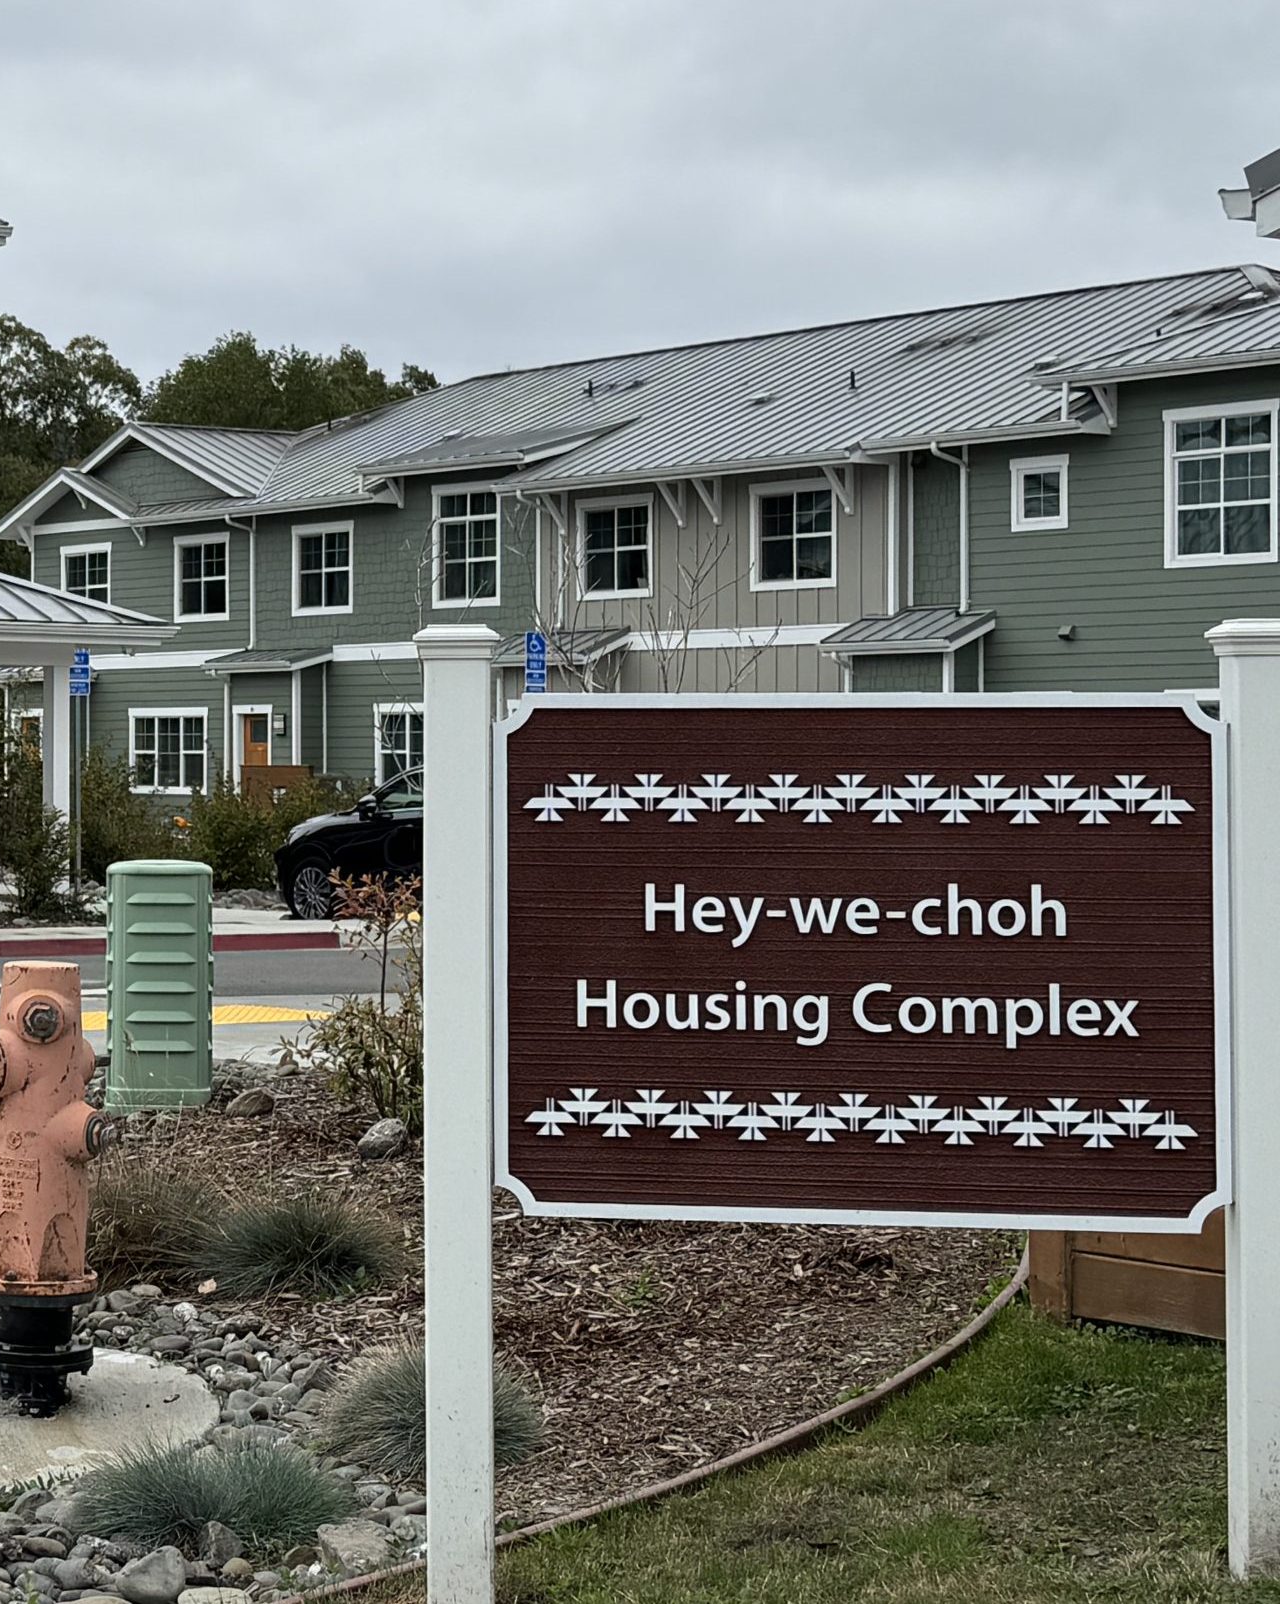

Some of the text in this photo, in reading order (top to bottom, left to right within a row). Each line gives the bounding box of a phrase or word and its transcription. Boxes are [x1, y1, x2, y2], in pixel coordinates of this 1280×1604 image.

[644, 882, 1068, 949] Hey-we-choh
[575, 978, 1141, 1049] Housing Complex
